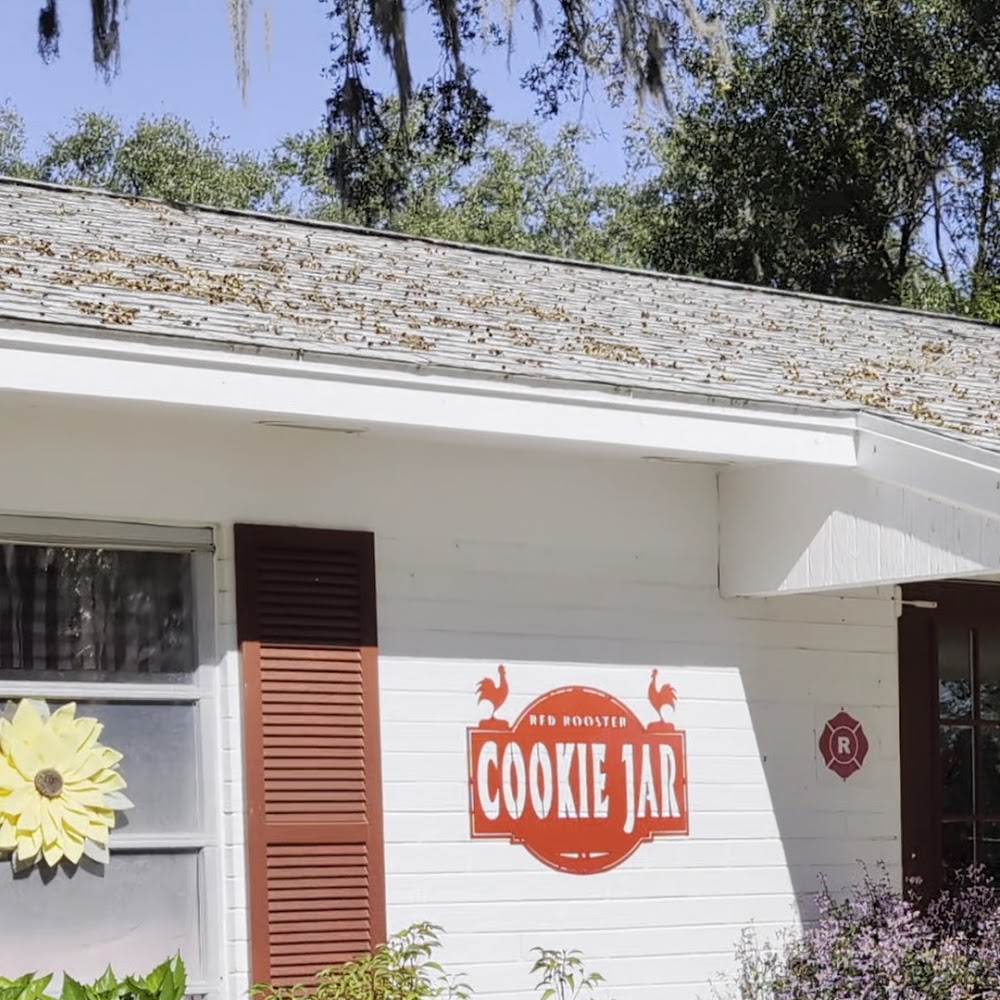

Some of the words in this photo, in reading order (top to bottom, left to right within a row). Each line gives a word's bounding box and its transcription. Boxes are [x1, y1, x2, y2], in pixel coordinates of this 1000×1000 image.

[529, 714, 556, 726] RED
[563, 715, 627, 728] ROOSTER
[837, 736, 851, 754] R
[477, 740, 610, 820] COOKIE
[622, 743, 681, 834] JAR
